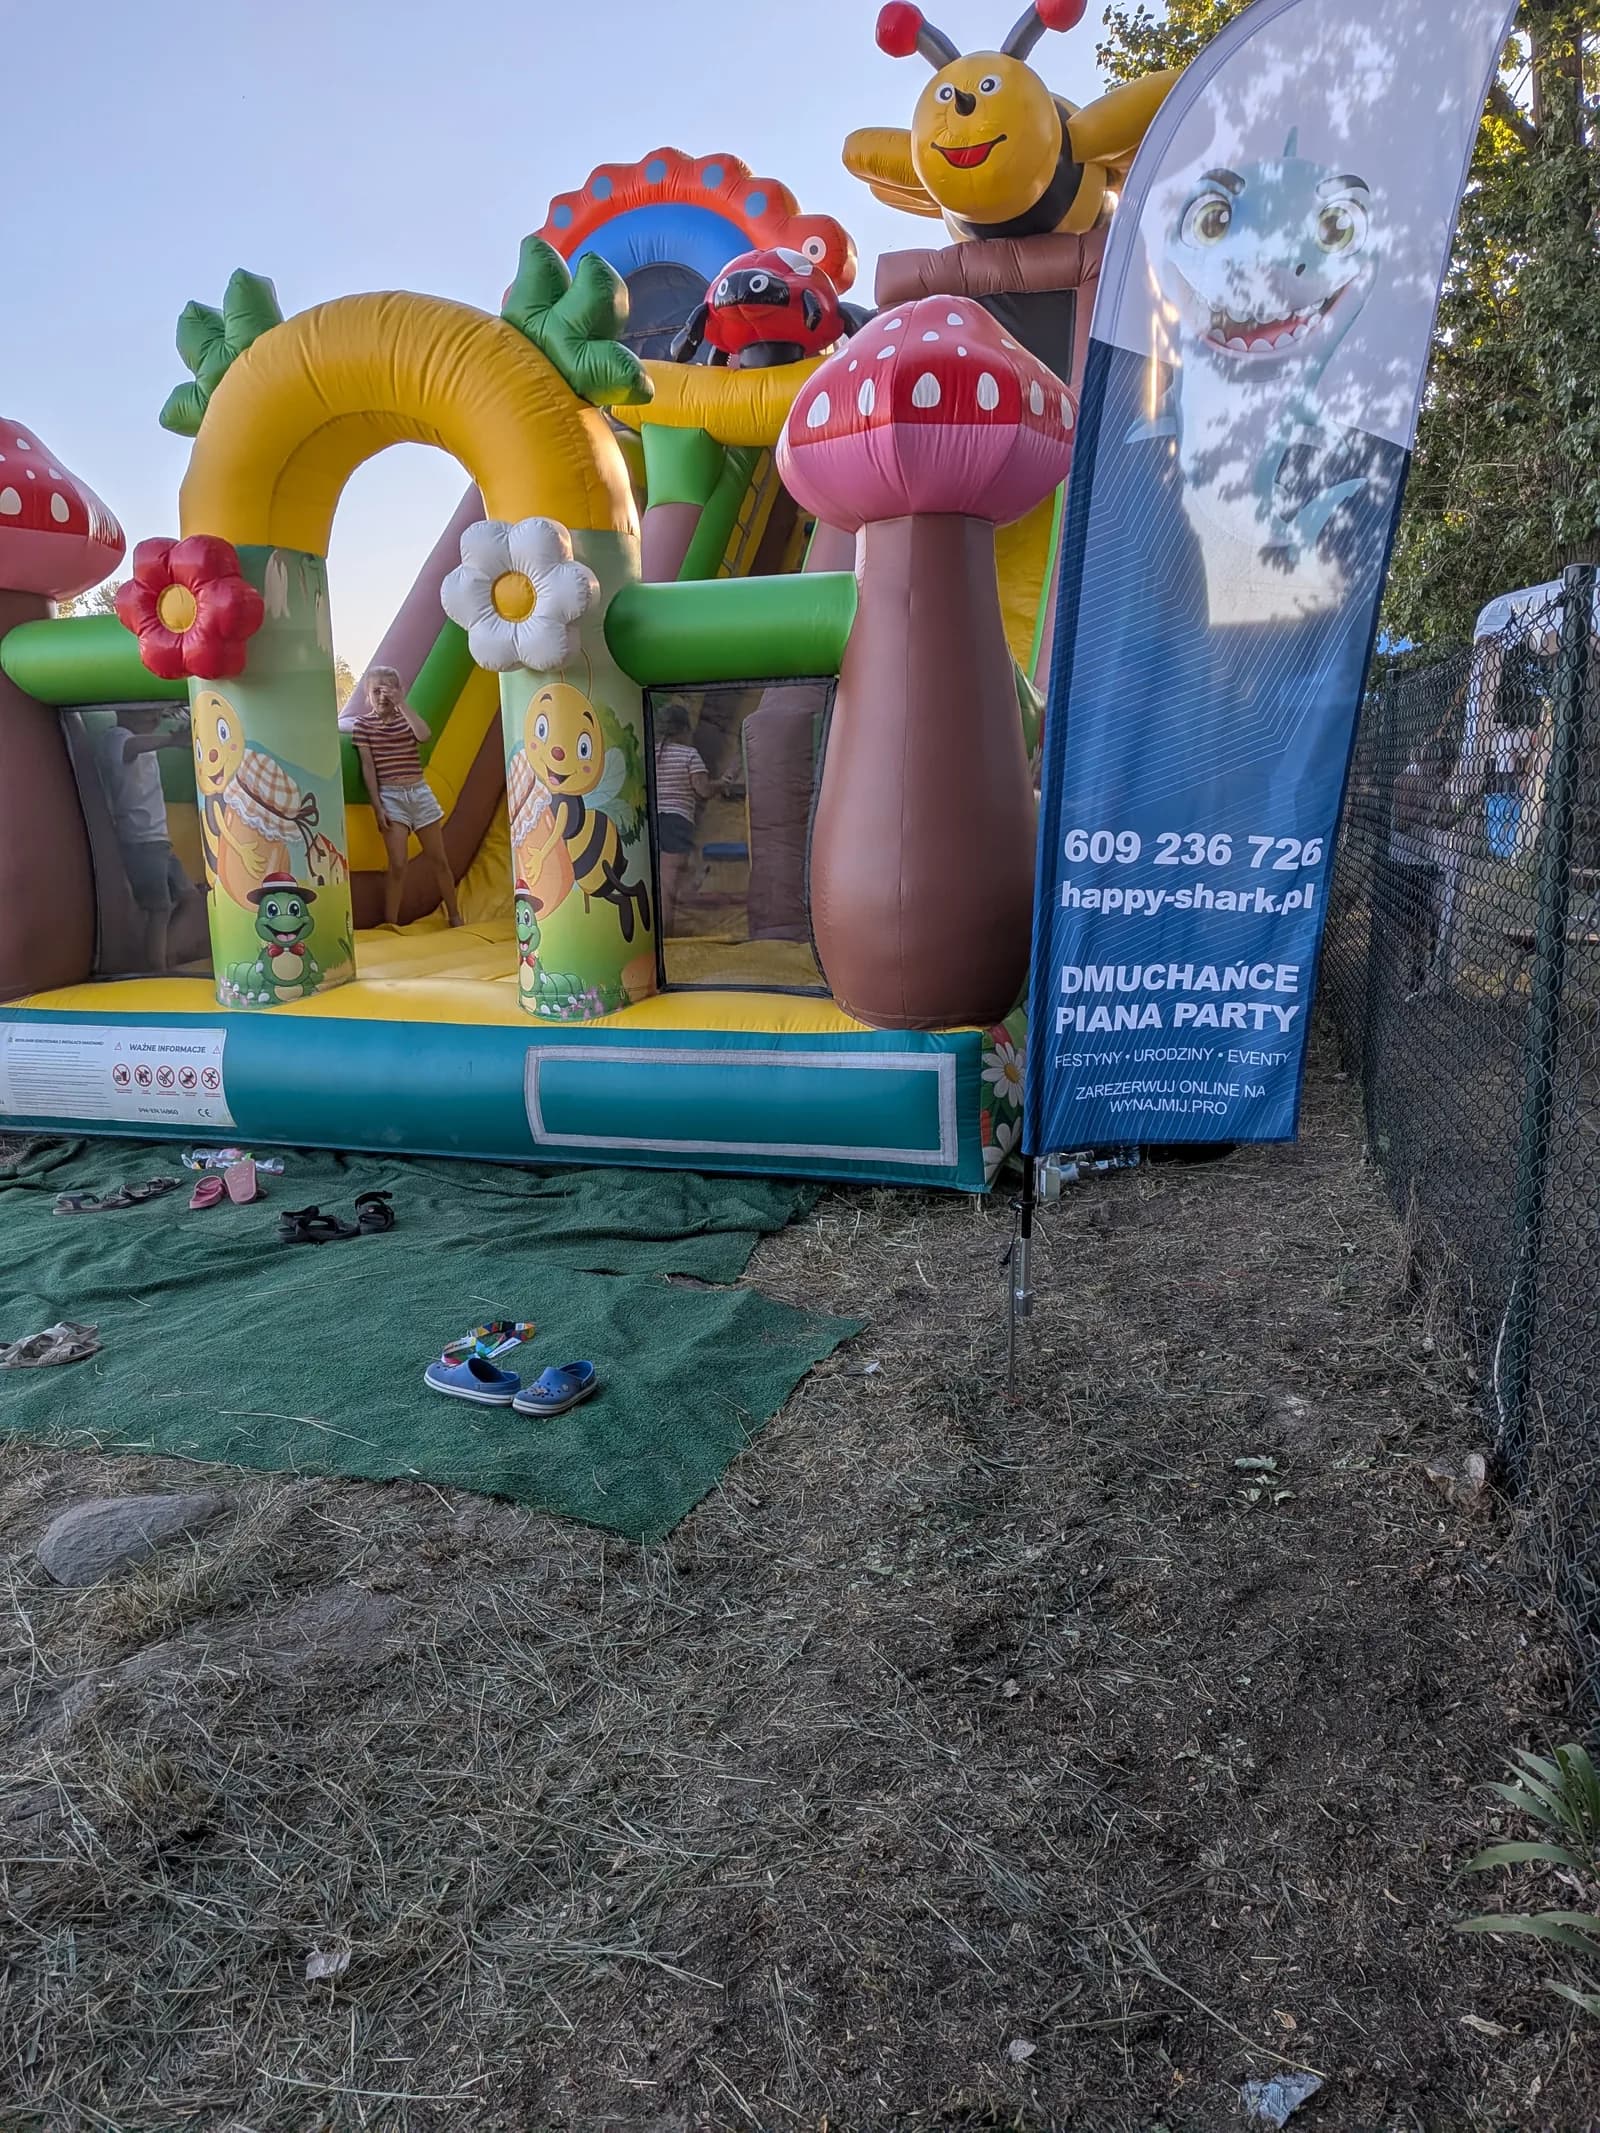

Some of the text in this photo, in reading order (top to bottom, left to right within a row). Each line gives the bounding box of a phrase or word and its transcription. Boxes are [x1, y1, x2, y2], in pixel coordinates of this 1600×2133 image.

[1064, 829, 1323, 871] 609 236 726
[1060, 880, 1315, 916] happy-shark.pl
[1060, 960, 1299, 994] DMUCHAŃCE
[1055, 1003, 1299, 1034] PIANA PARTY
[129, 1042, 206, 1053] WAŻNE INFORMACJE
[1055, 1047, 1291, 1069] FESTYNY URODZINY EVENTY
[1075, 1079, 1266, 1100] ZAREZERWUJ ONLINE NA
[1109, 1098, 1227, 1115] WYNAJMIJ.PRO
